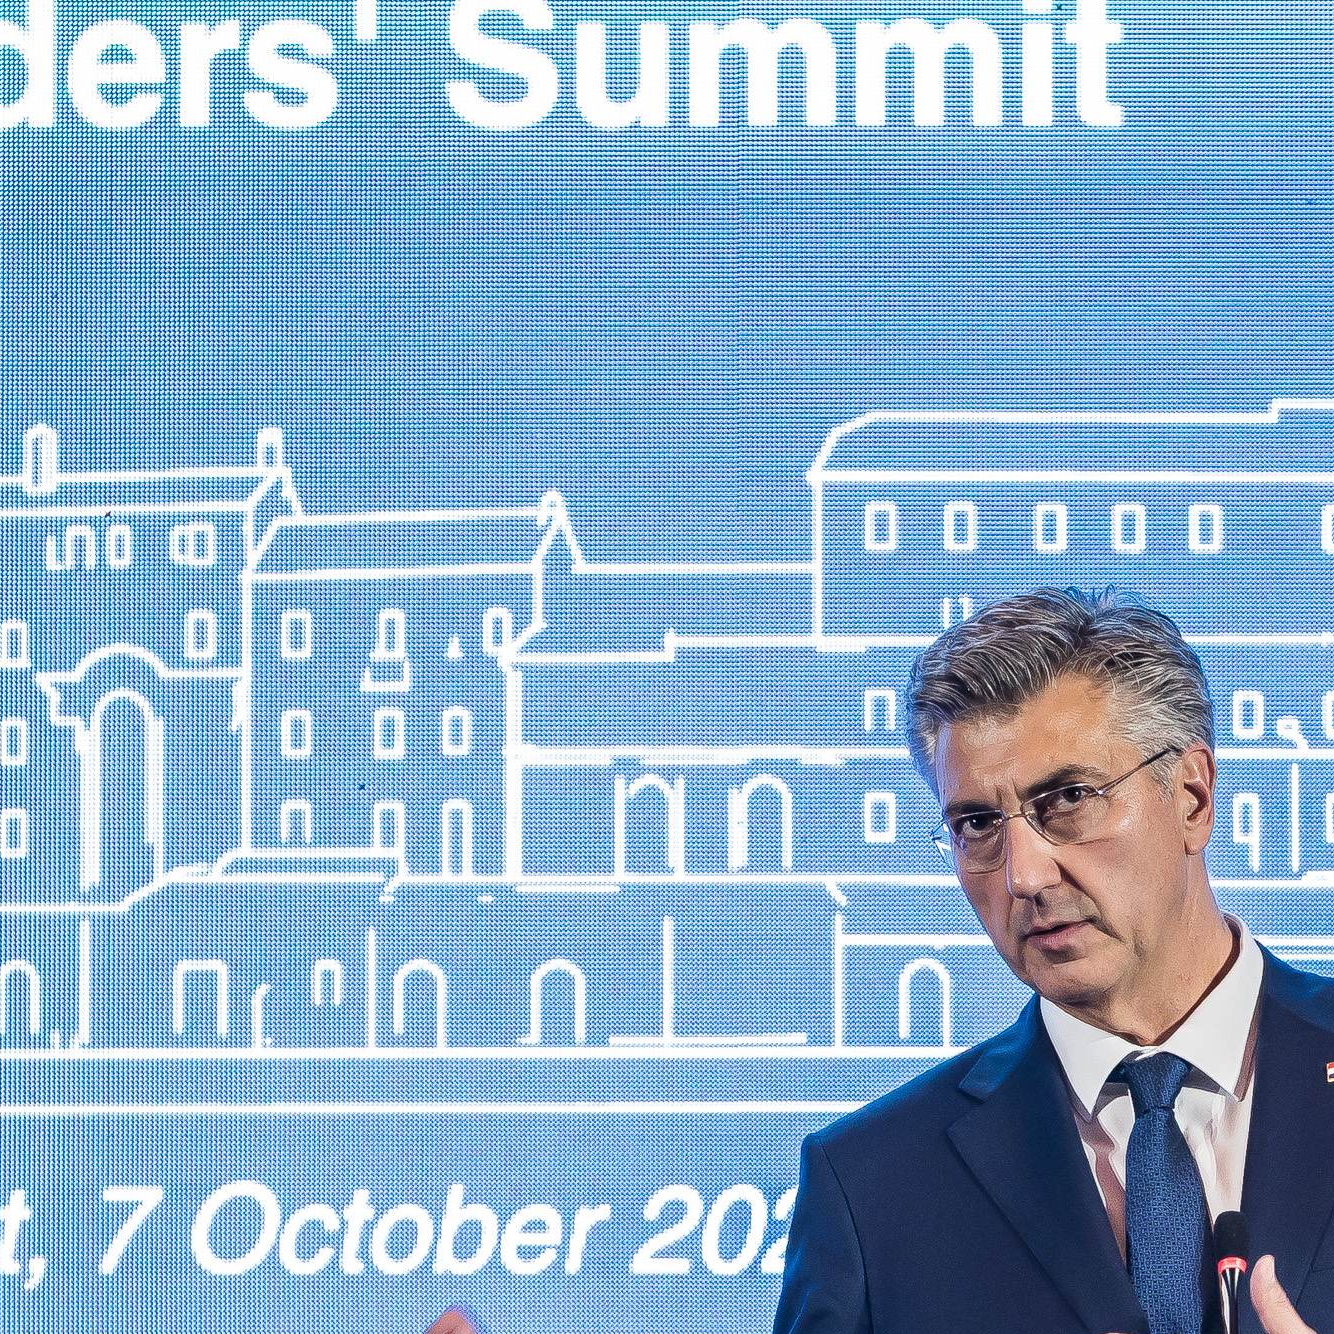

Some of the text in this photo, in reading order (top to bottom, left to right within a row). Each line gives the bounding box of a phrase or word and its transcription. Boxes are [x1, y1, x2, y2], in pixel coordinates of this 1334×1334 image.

[445, 0, 1124, 131] Summit
[98, 1184, 165, 1276] 7
[189, 1178, 612, 1277] October
